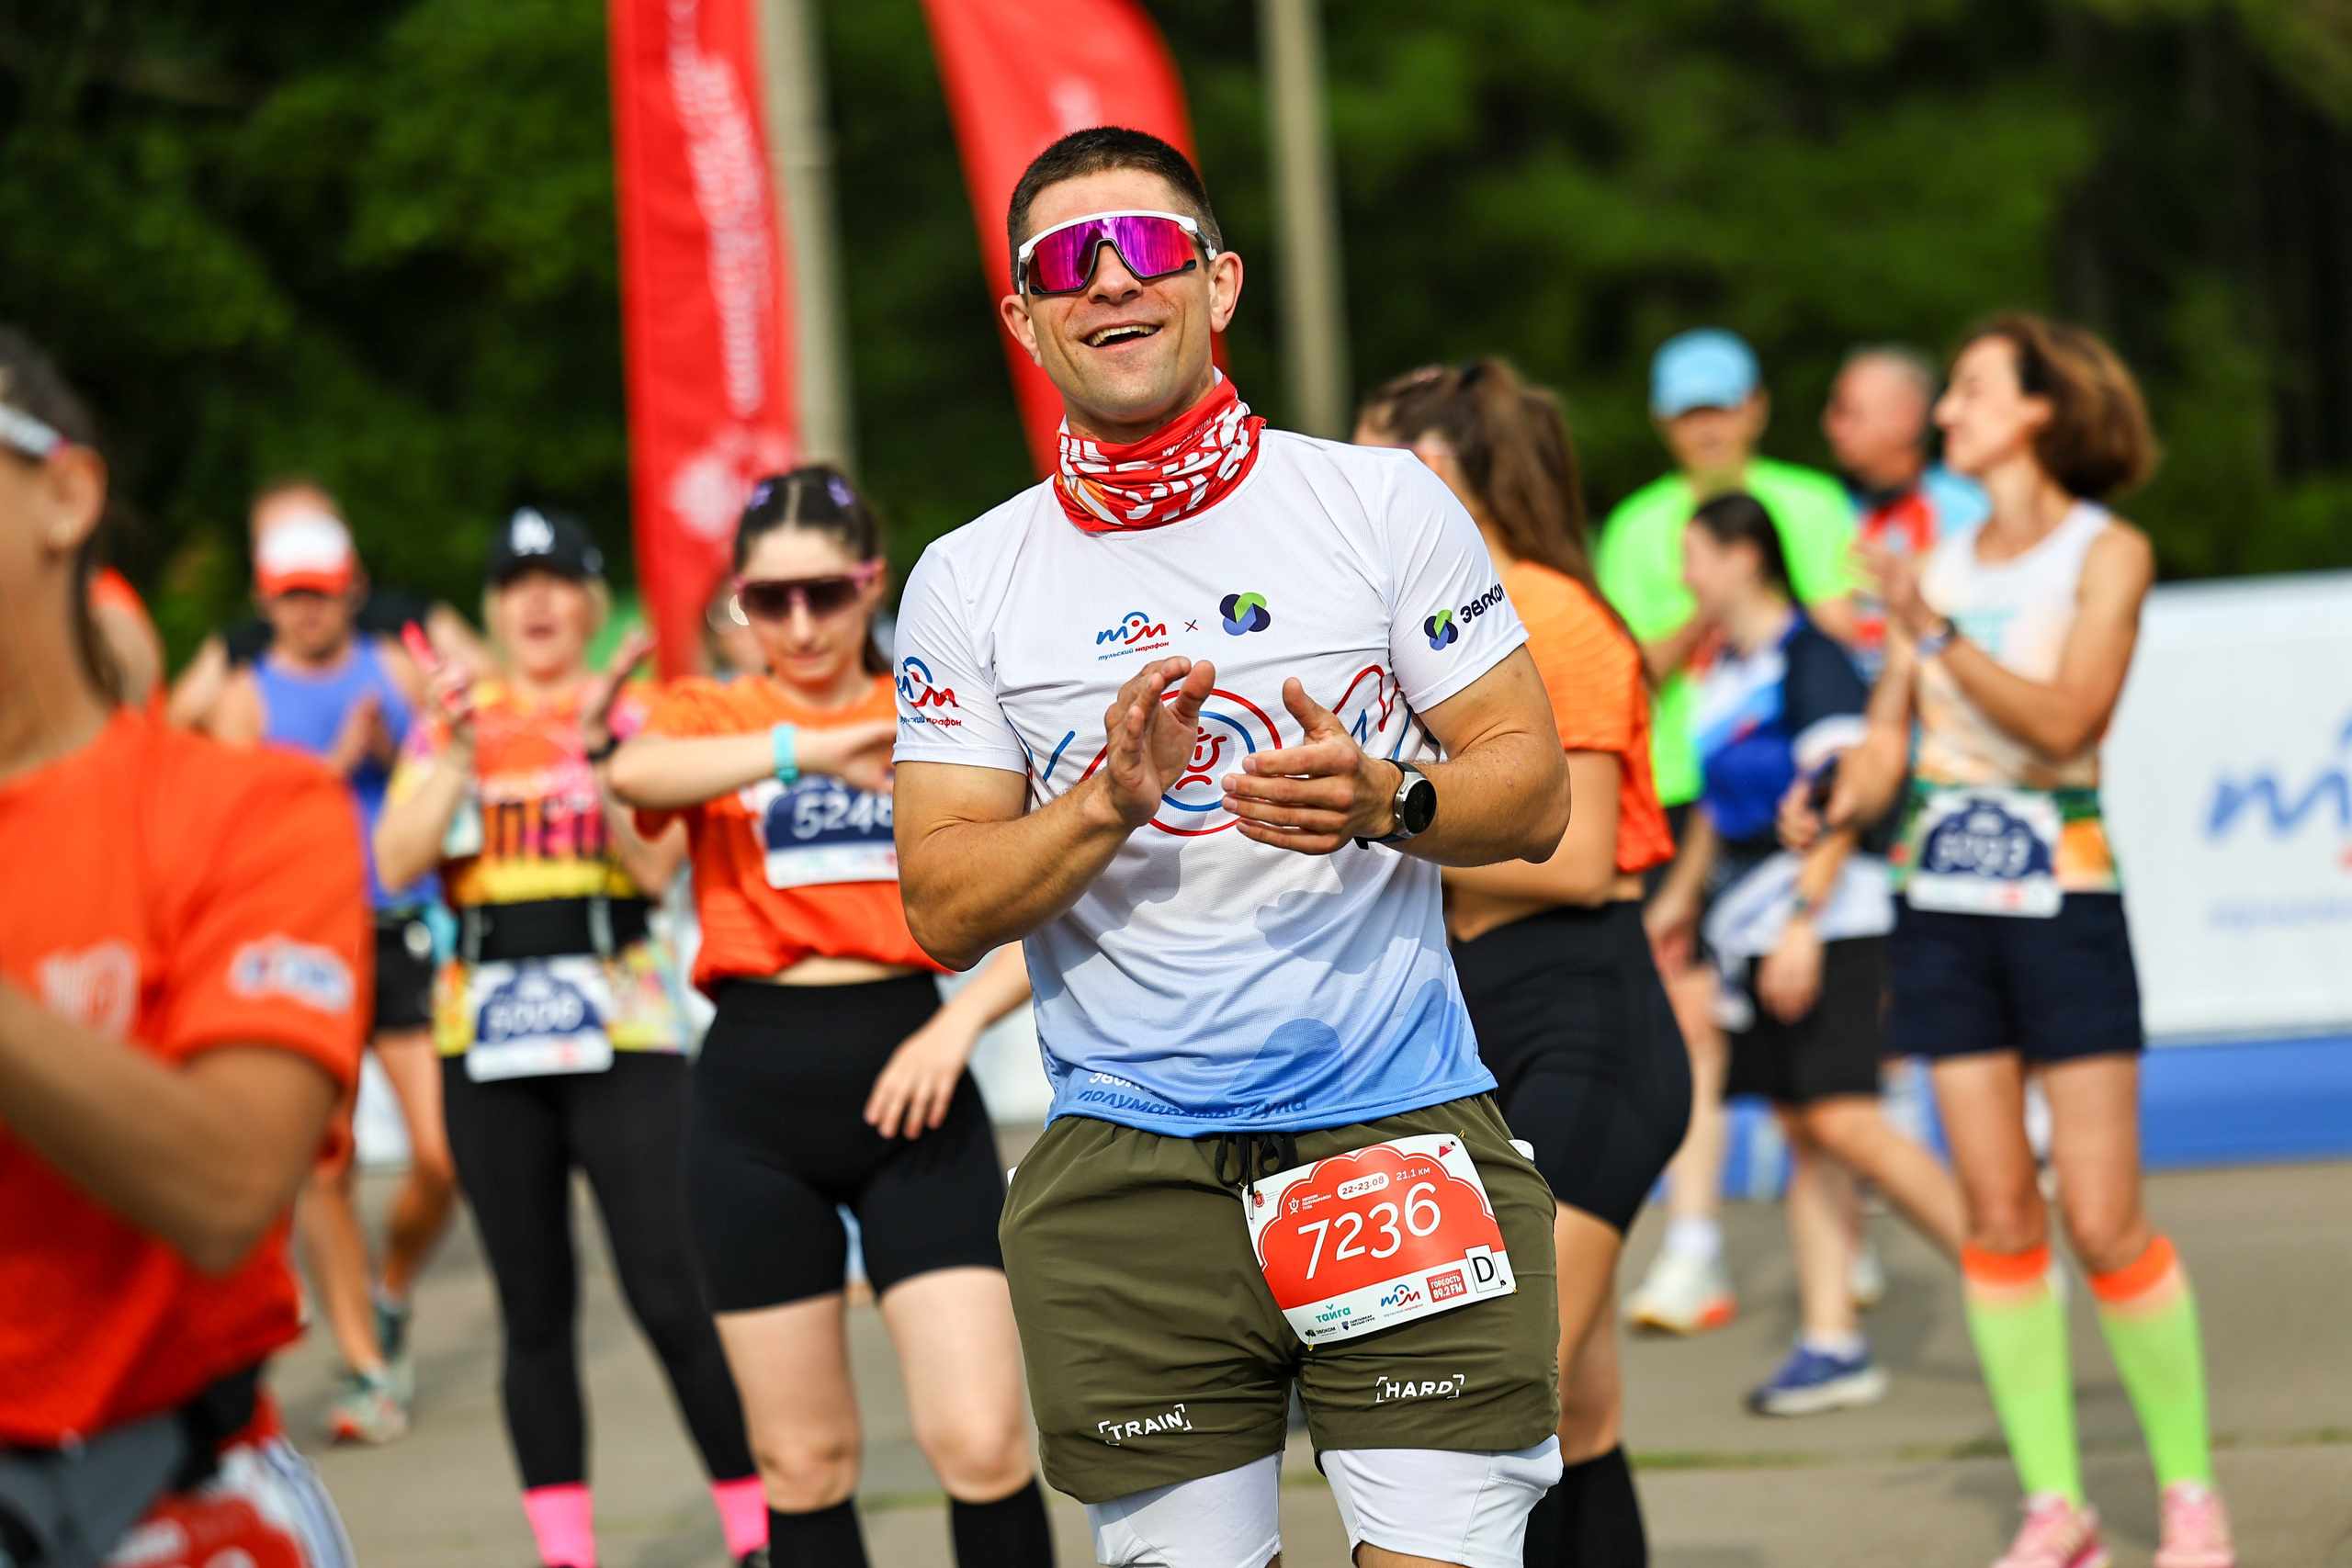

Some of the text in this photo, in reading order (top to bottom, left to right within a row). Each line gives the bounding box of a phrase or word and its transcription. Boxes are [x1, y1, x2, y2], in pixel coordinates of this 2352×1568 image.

[1098, 642, 1170, 660] тульский марафон
[1396, 1168, 1417, 1181] 21,1
[1341, 1175, 1385, 1195] 22-23.08
[1297, 1181, 1442, 1280] 7236
[1472, 1256, 1495, 1283] D
[1432, 1281, 1464, 1300] 89.2 FM
[1315, 1303, 1351, 1323] тайга
[1385, 1381, 1453, 1398] HARD
[1107, 1410, 1183, 1440] TRAIN
